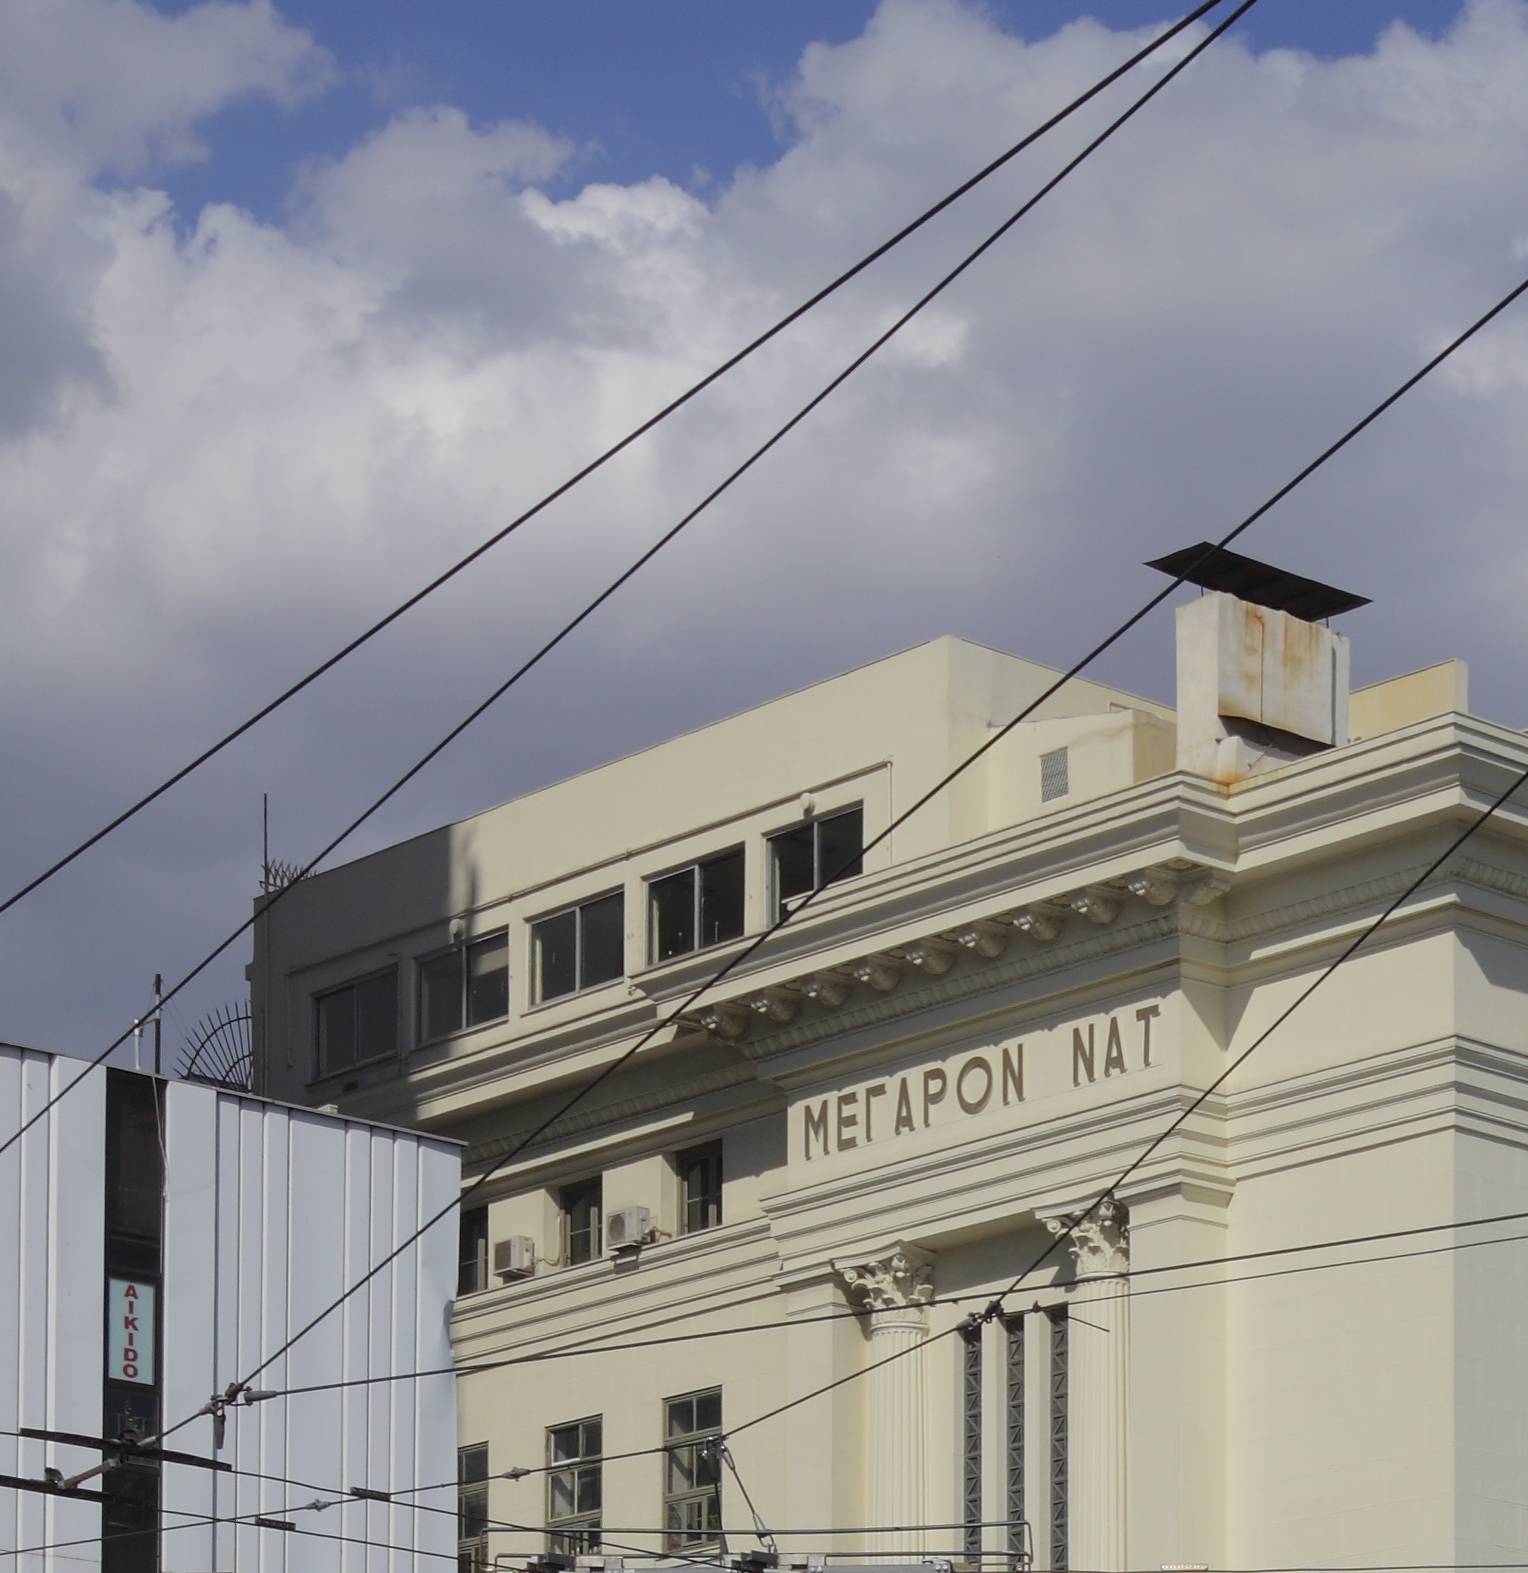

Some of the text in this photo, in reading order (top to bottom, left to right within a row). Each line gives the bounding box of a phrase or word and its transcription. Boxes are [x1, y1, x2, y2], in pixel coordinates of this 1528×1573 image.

[804, 1004, 1160, 1160] ΜΕΓΑΡΟΝ ΝΑΤ
[123, 1284, 139, 1378] AIKIDO
